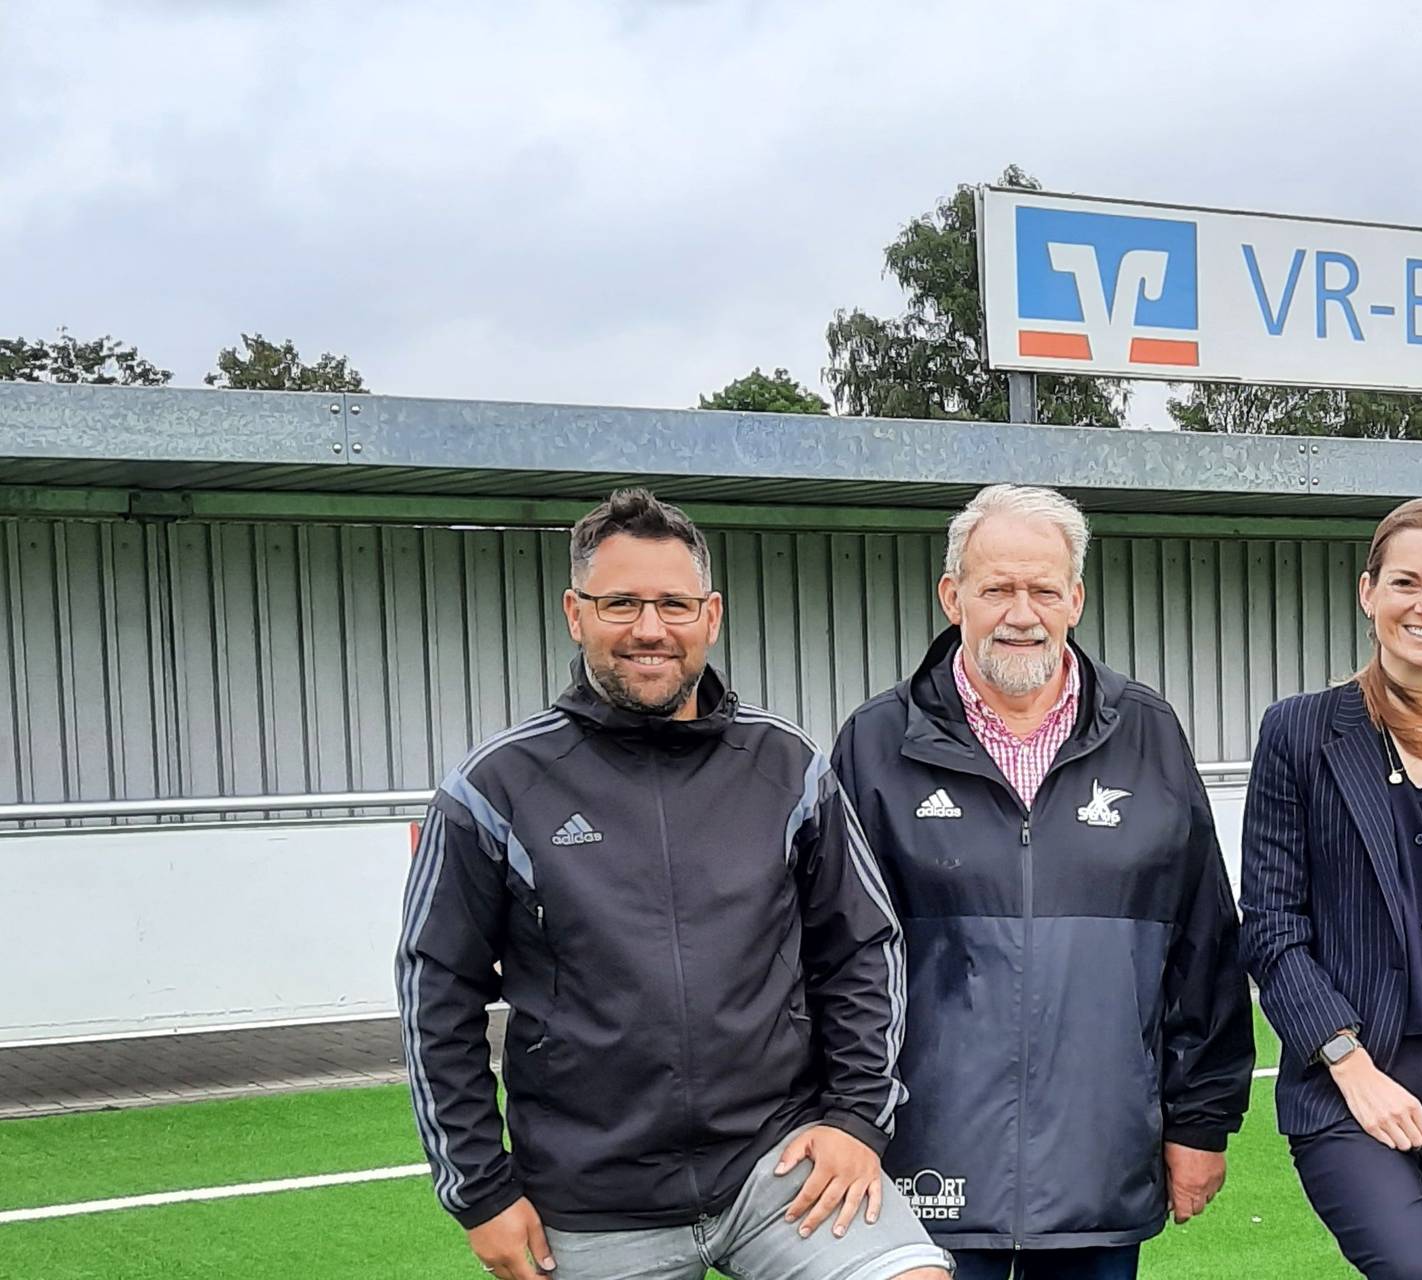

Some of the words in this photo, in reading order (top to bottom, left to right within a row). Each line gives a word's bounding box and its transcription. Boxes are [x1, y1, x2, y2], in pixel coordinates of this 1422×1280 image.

[916, 806, 963, 818] adidas
[551, 831, 602, 846] adidas
[895, 1168, 966, 1197] SPORT
[912, 1205, 960, 1218] ÖDDE
